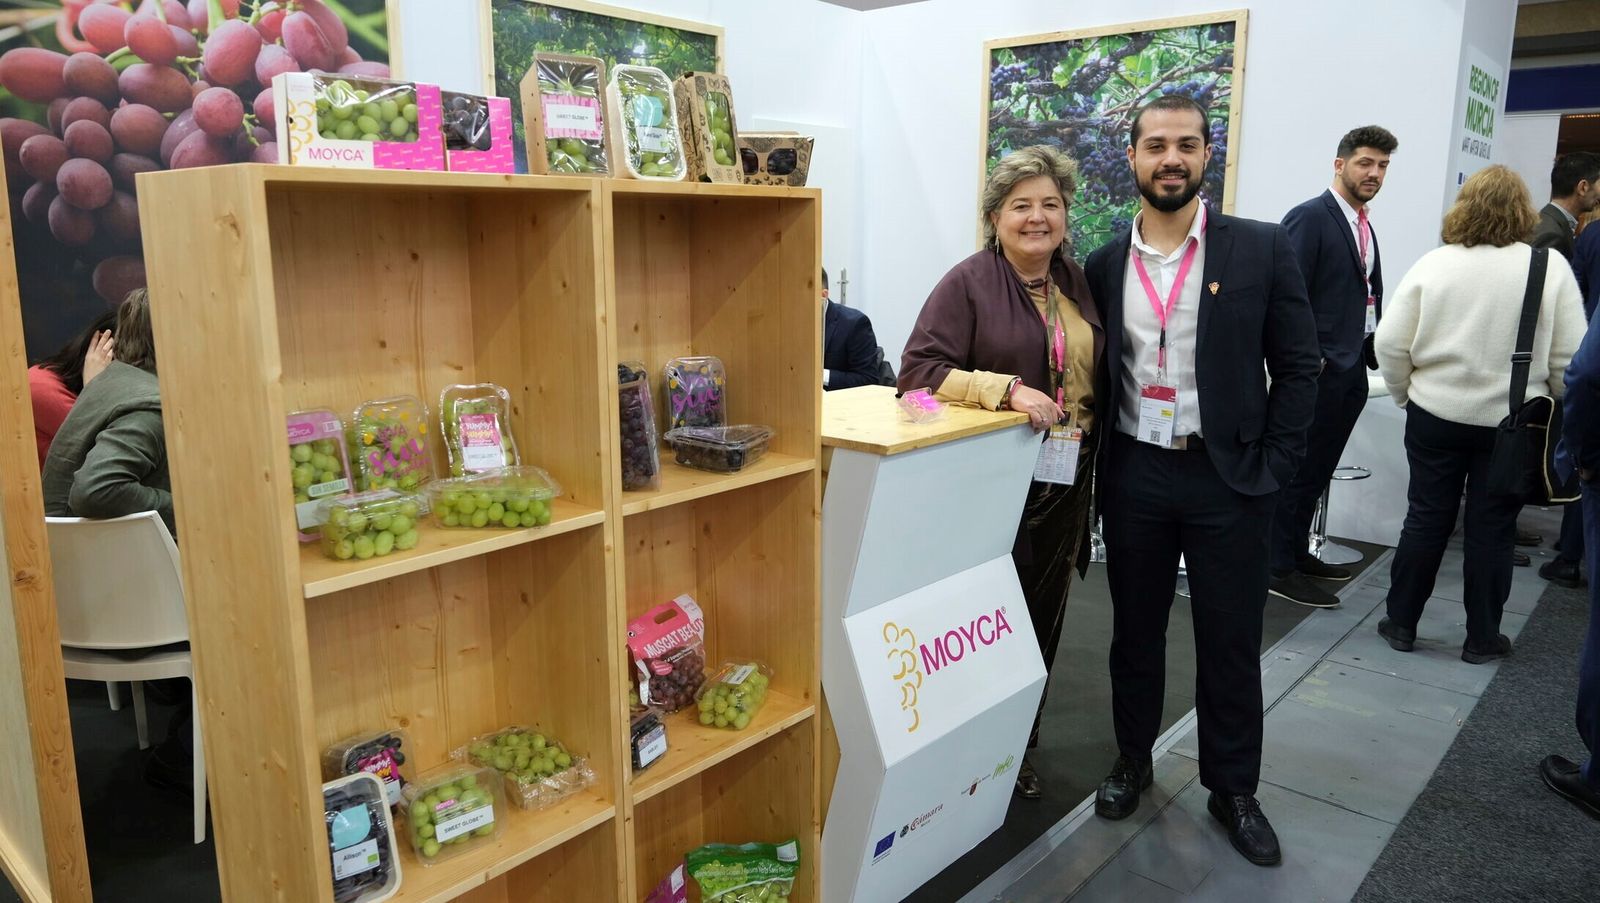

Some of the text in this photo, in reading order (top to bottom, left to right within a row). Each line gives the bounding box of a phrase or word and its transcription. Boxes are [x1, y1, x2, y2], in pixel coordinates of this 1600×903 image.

[1469, 64, 1492, 100] REGION
[1464, 96, 1495, 139] MURCIA
[643, 630, 681, 658] MUSCAT
[443, 822, 461, 834] SWEET
